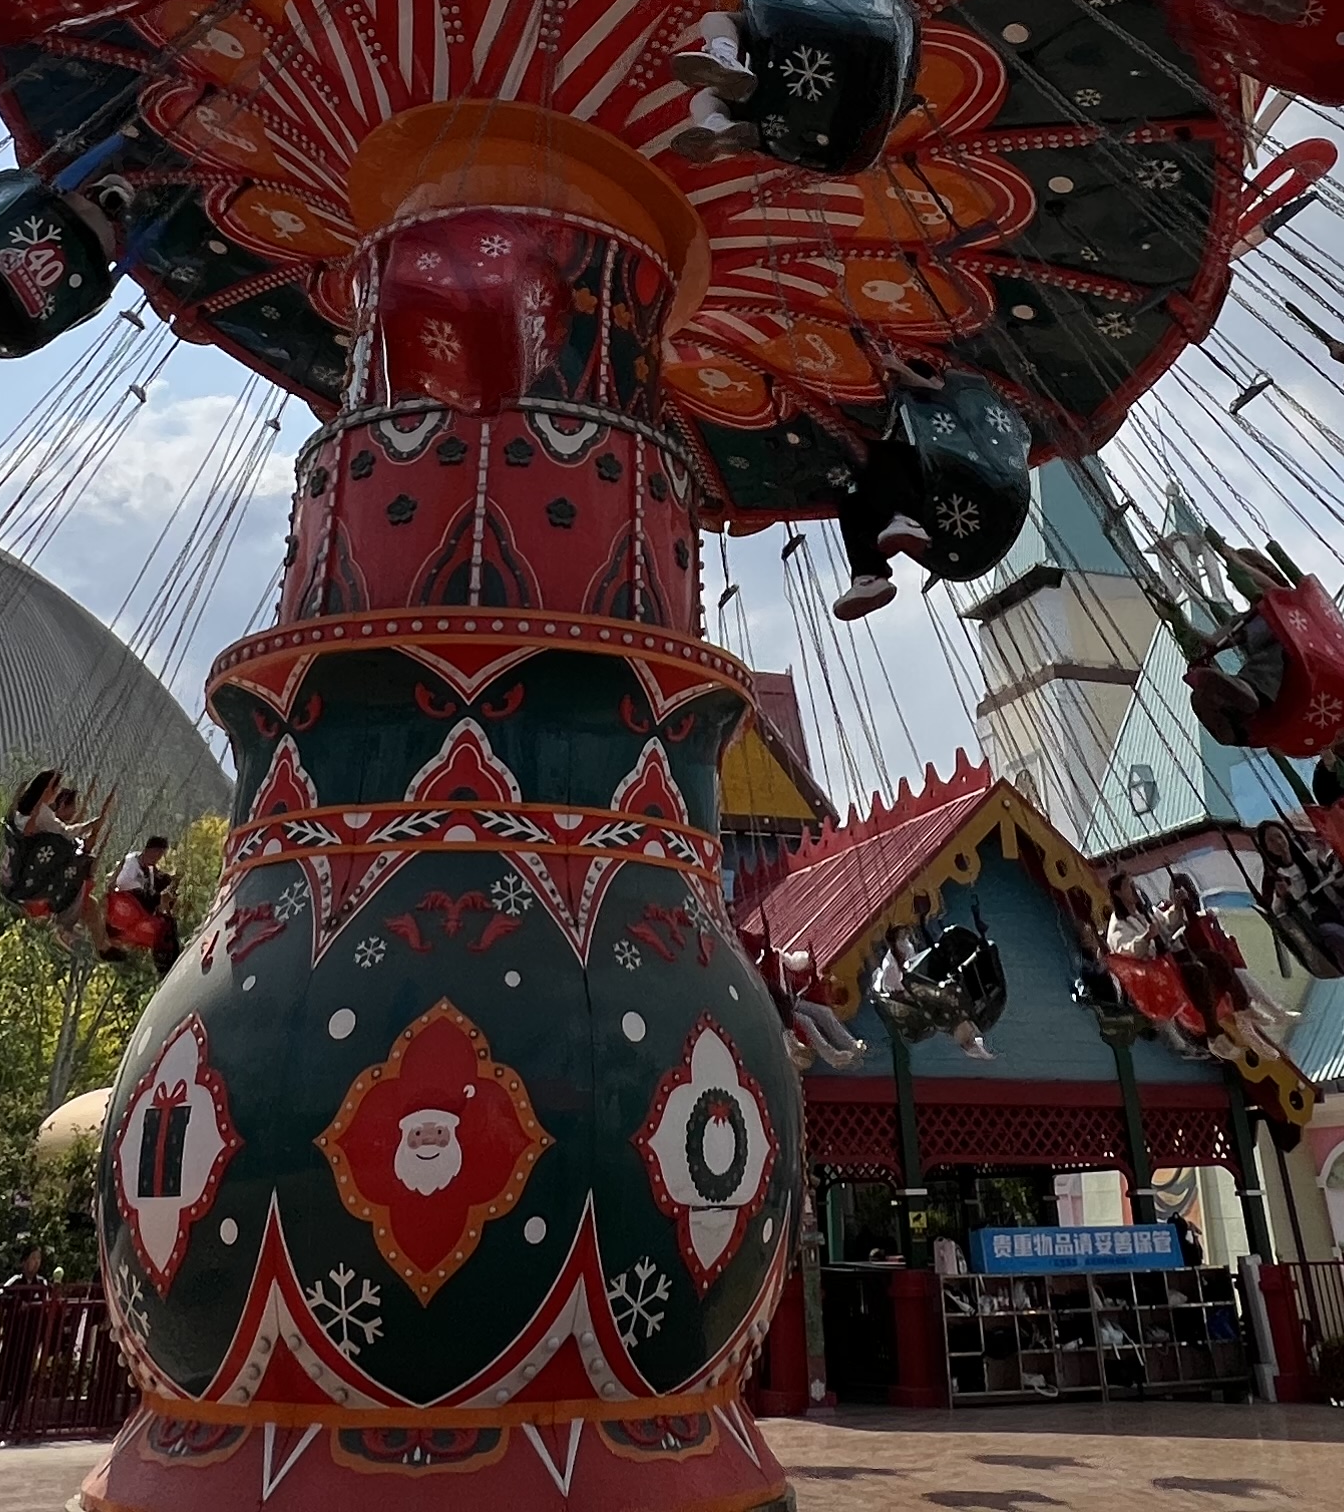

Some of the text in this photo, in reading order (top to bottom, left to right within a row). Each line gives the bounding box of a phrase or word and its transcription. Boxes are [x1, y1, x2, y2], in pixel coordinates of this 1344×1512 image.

[27, 249, 65, 287] 40
[992, 1230, 1172, 1258] 贵重物品请妥善保管
